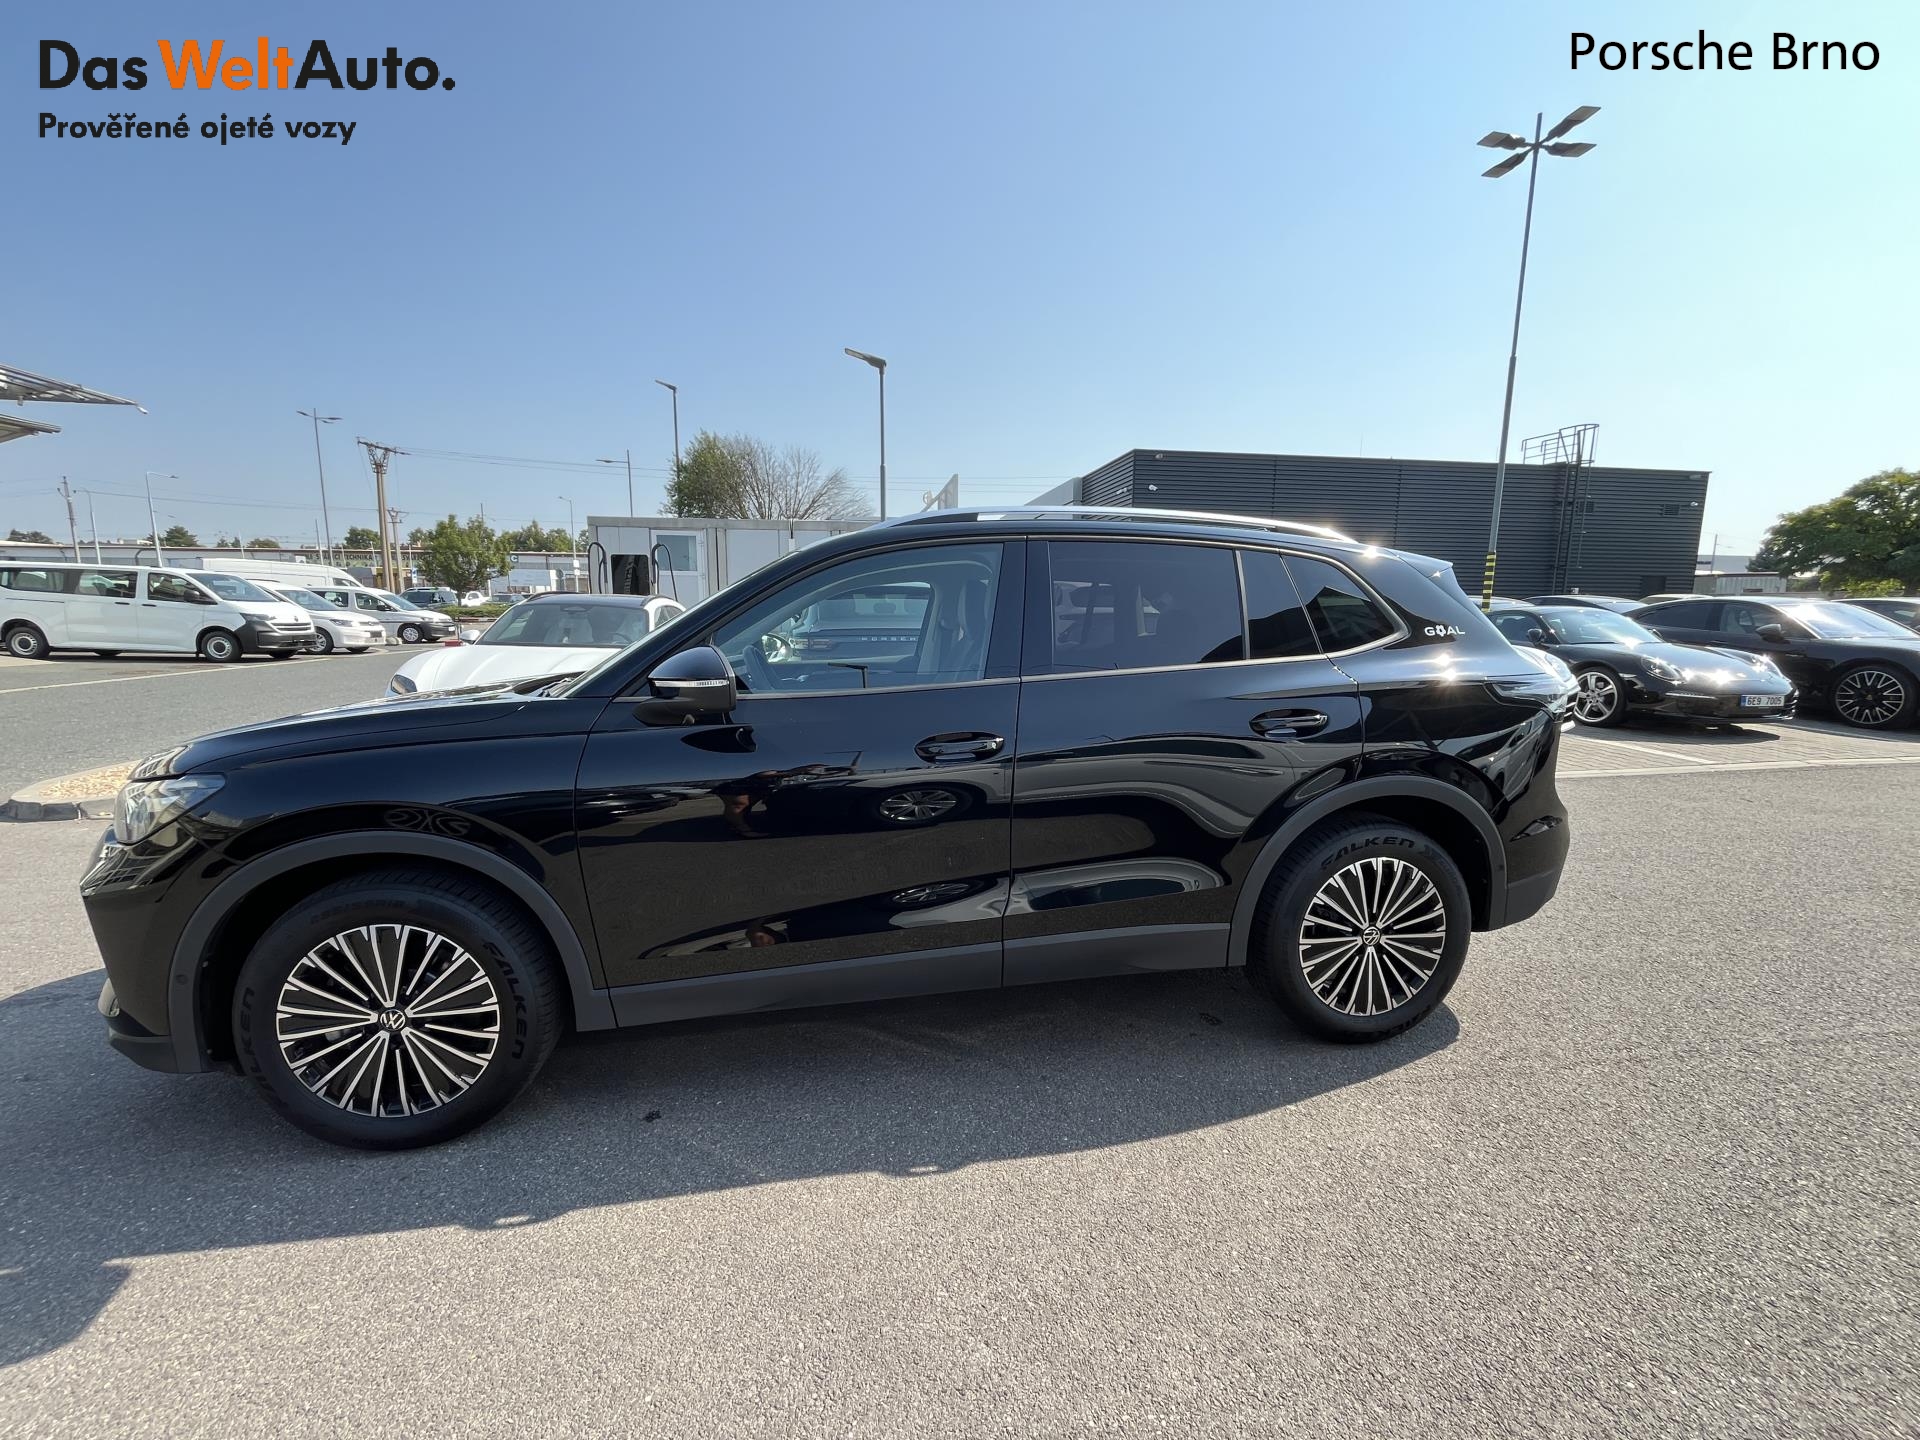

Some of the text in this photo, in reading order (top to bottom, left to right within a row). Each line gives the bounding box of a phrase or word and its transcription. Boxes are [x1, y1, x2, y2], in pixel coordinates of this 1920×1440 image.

[1424, 625, 1466, 637] GOAL
[1747, 697, 1782, 705] 6E9 7005
[1320, 836, 1416, 871] FALKEN
[483, 939, 528, 1061] FALKEN
